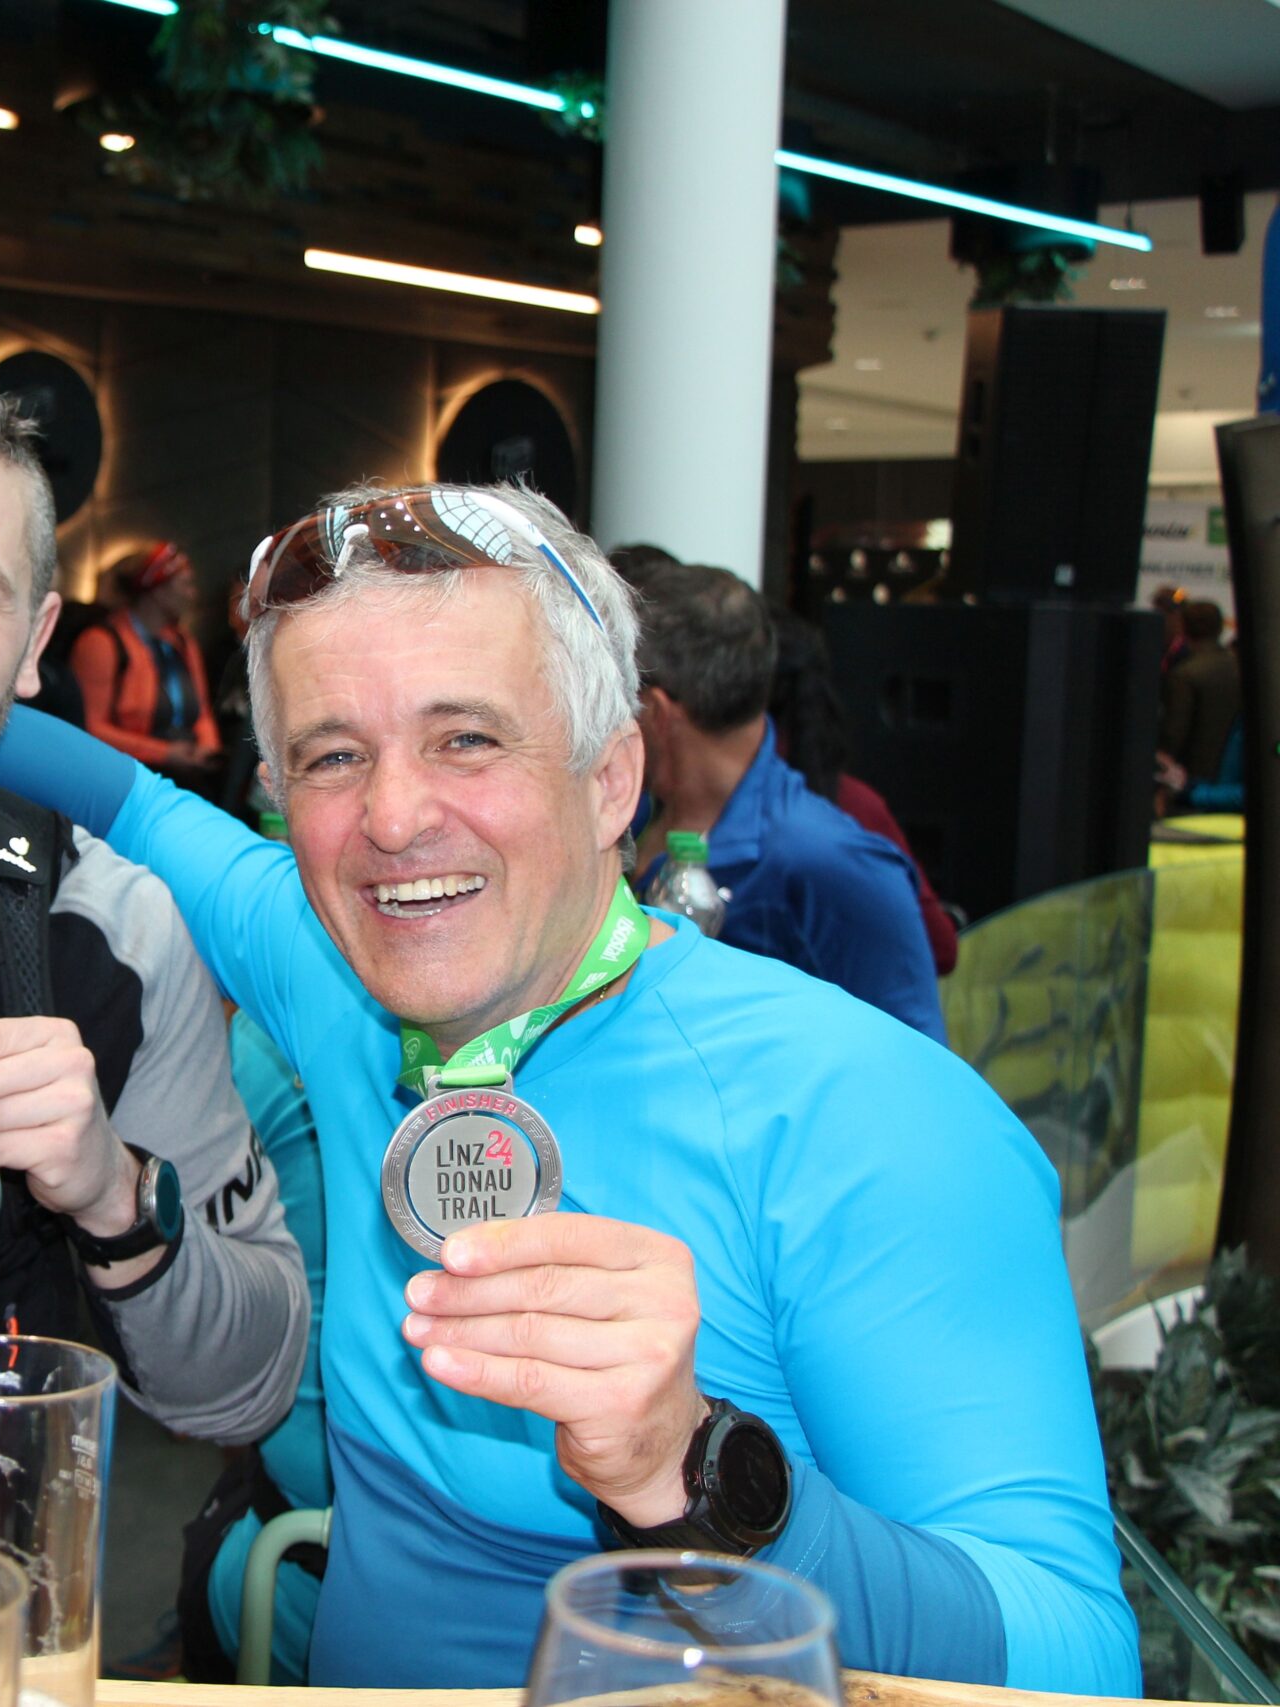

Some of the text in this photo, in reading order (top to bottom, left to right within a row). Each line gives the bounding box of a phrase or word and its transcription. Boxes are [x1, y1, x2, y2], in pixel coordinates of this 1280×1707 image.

[425, 1092, 518, 1121] FINISHER
[436, 1130, 513, 1168] LINZ 24
[436, 1168, 512, 1195] DONAU
[437, 1195, 507, 1221] TRAIL
